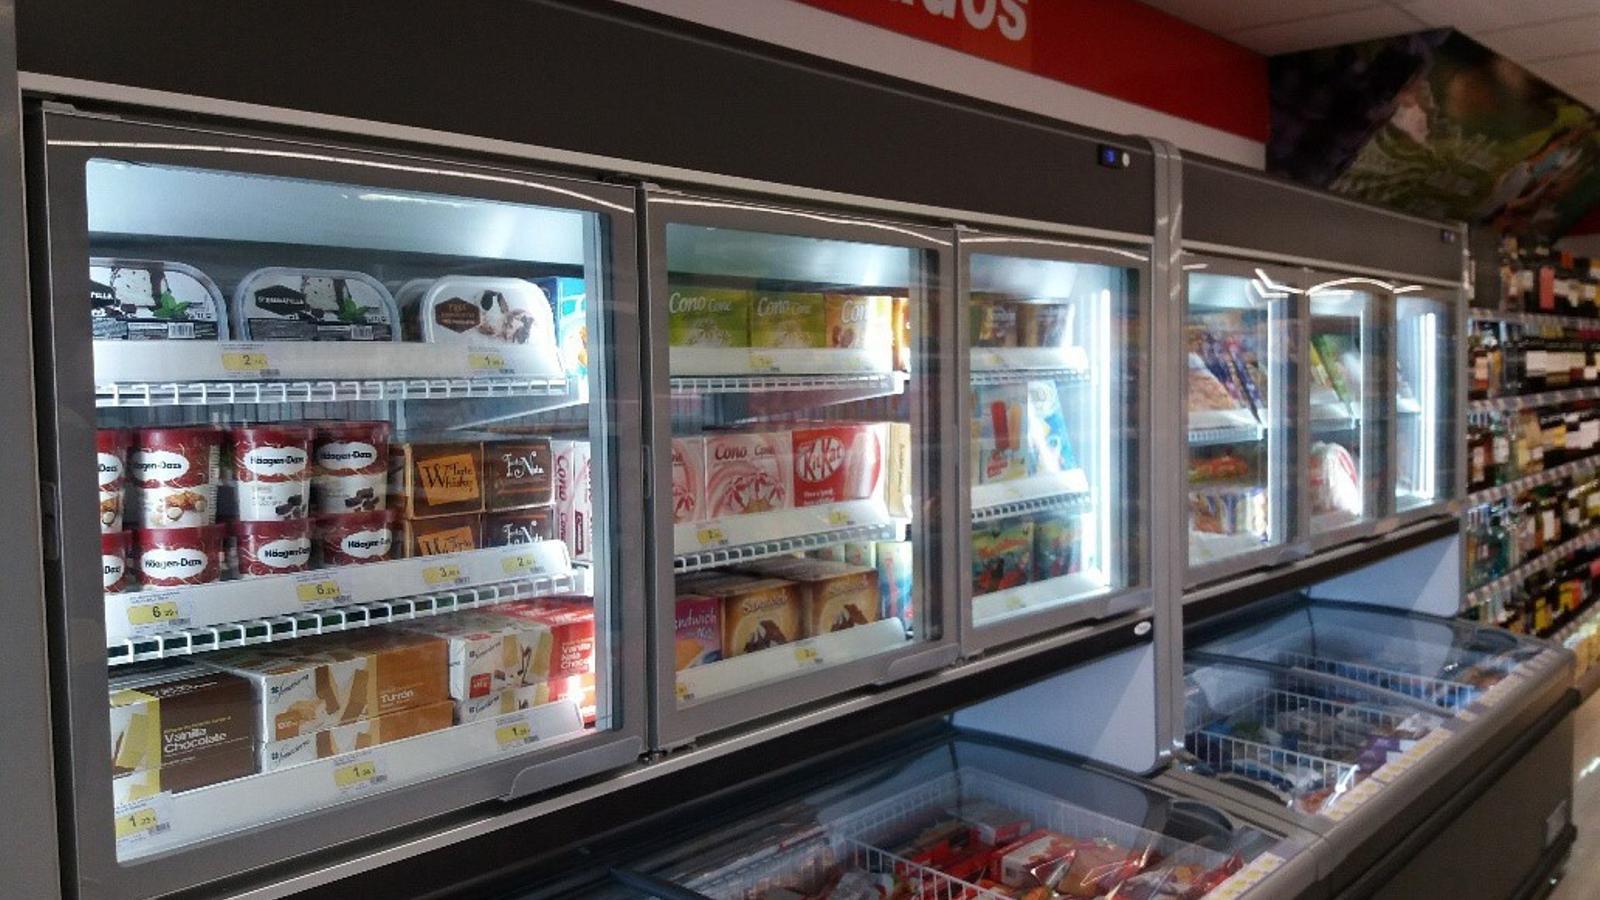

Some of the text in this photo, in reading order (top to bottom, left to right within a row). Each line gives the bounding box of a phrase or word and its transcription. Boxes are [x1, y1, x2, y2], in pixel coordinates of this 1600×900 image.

[669, 292, 706, 313] Cono
[715, 446, 748, 460] Cono
[803, 437, 842, 480] KitKat
[164, 732, 228, 753] Chocolate
